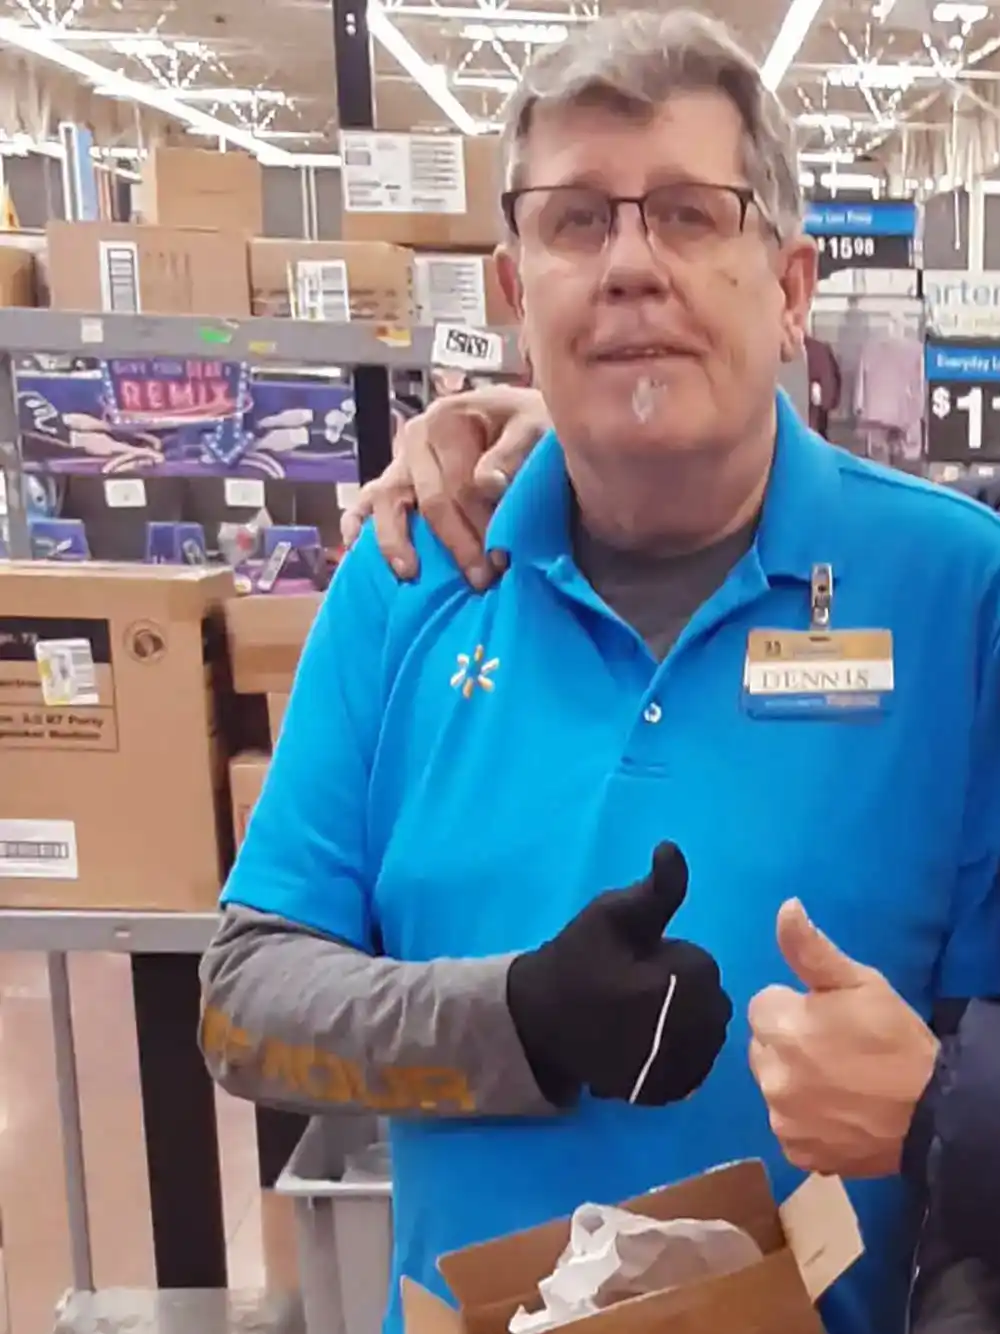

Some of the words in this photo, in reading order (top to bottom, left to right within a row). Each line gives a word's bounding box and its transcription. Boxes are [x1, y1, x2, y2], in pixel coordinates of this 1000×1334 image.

[936, 352, 990, 372] Everyday
[119, 380, 236, 411] REMIX
[763, 669, 869, 688] DENNIS
